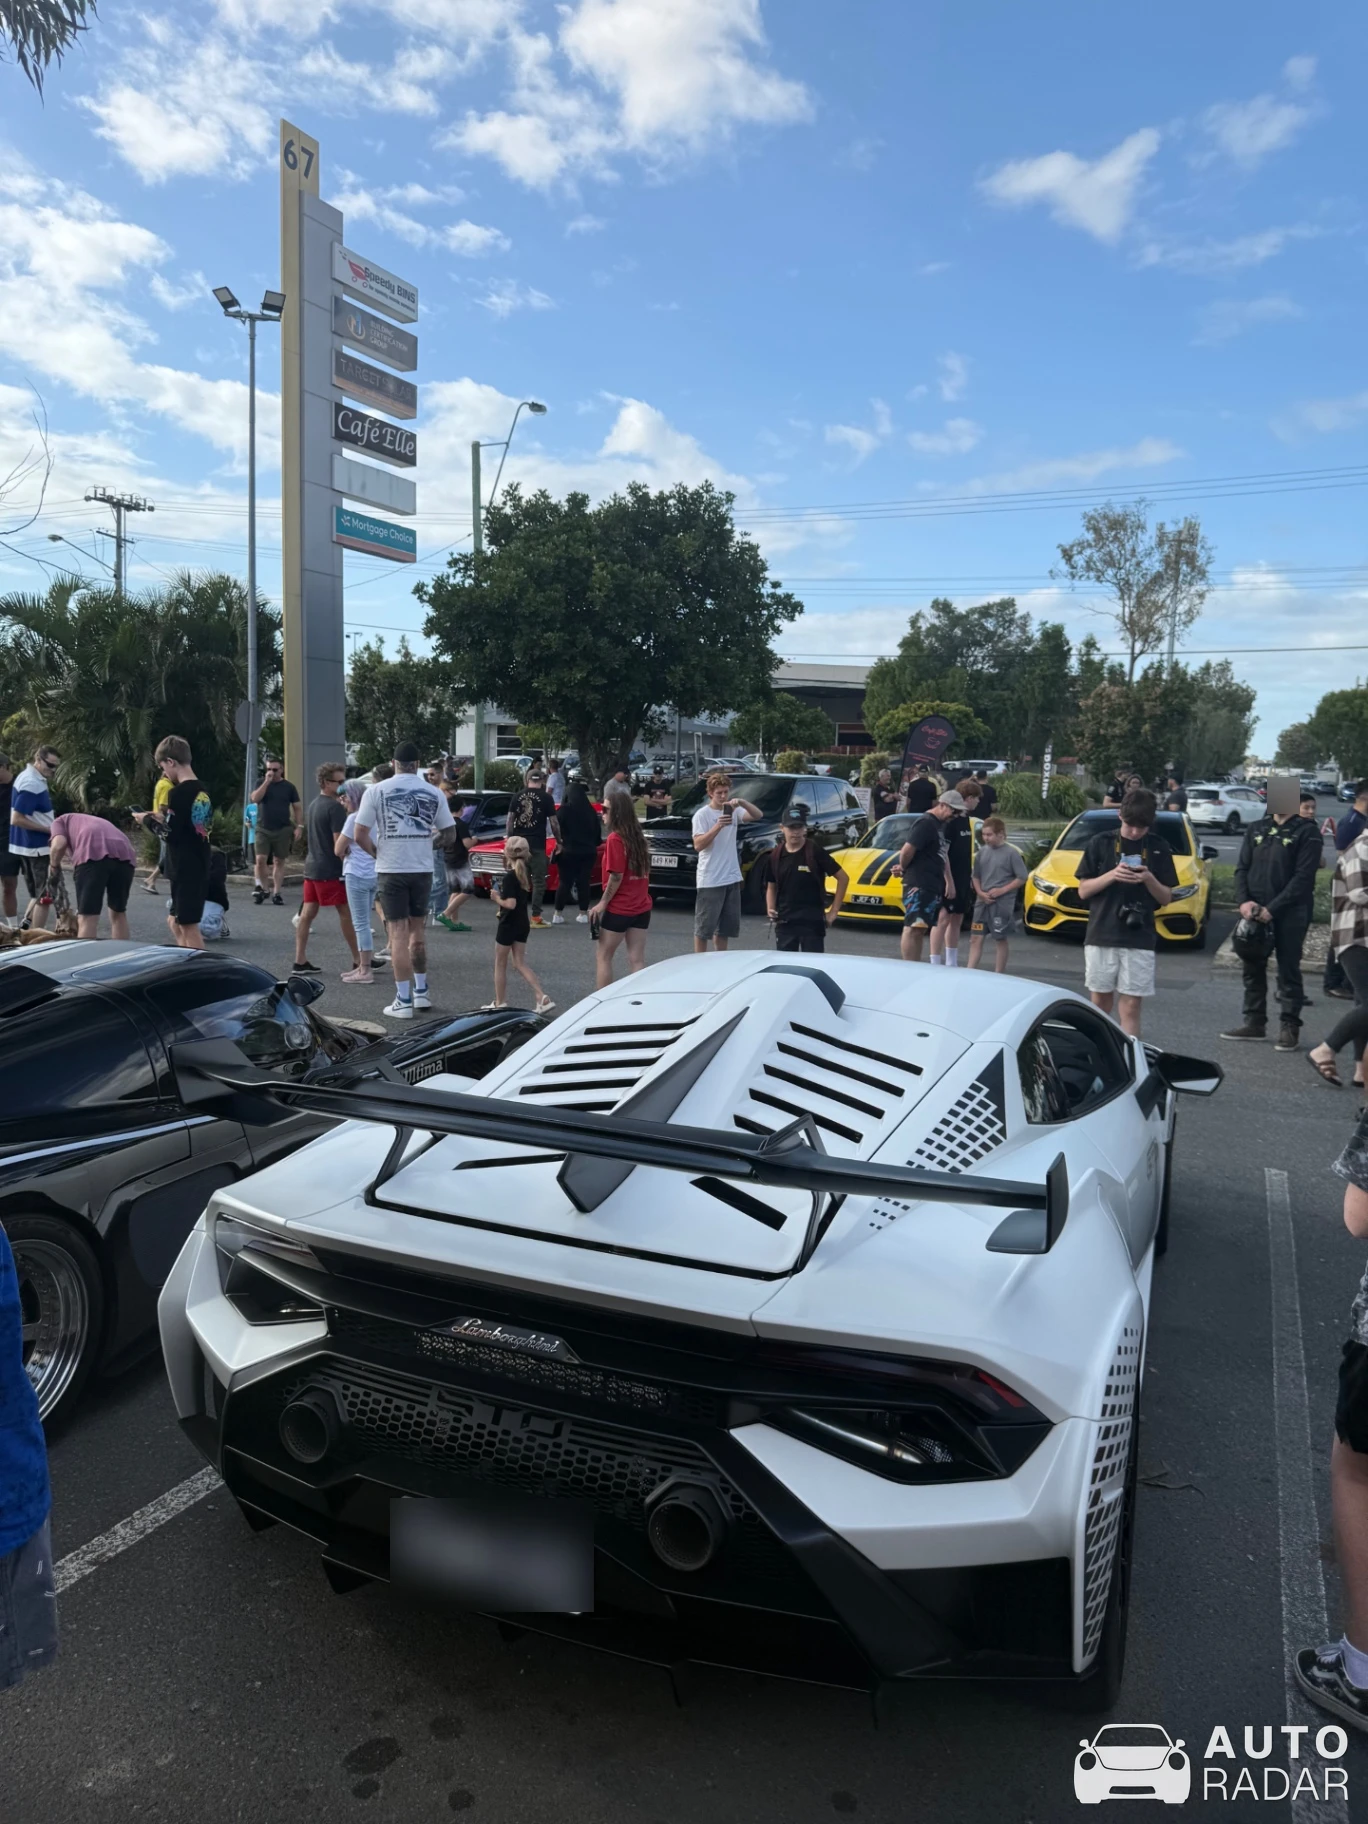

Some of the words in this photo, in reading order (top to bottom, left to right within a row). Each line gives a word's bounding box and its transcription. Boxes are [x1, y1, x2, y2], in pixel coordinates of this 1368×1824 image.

[283, 138, 315, 179] 67
[364, 266, 395, 294] Speedy
[397, 284, 416, 304] BINS
[370, 329, 408, 352] CERTIFICATION
[340, 358, 381, 387] TARGET
[337, 409, 380, 446] Café
[382, 427, 415, 456] Elle
[351, 518, 388, 538] Mortgage
[389, 529, 414, 544] Choice
[404, 1059, 443, 1084] Ultima
[451, 1318, 560, 1352] Lamborghini
[436, 1388, 565, 1439] STO
